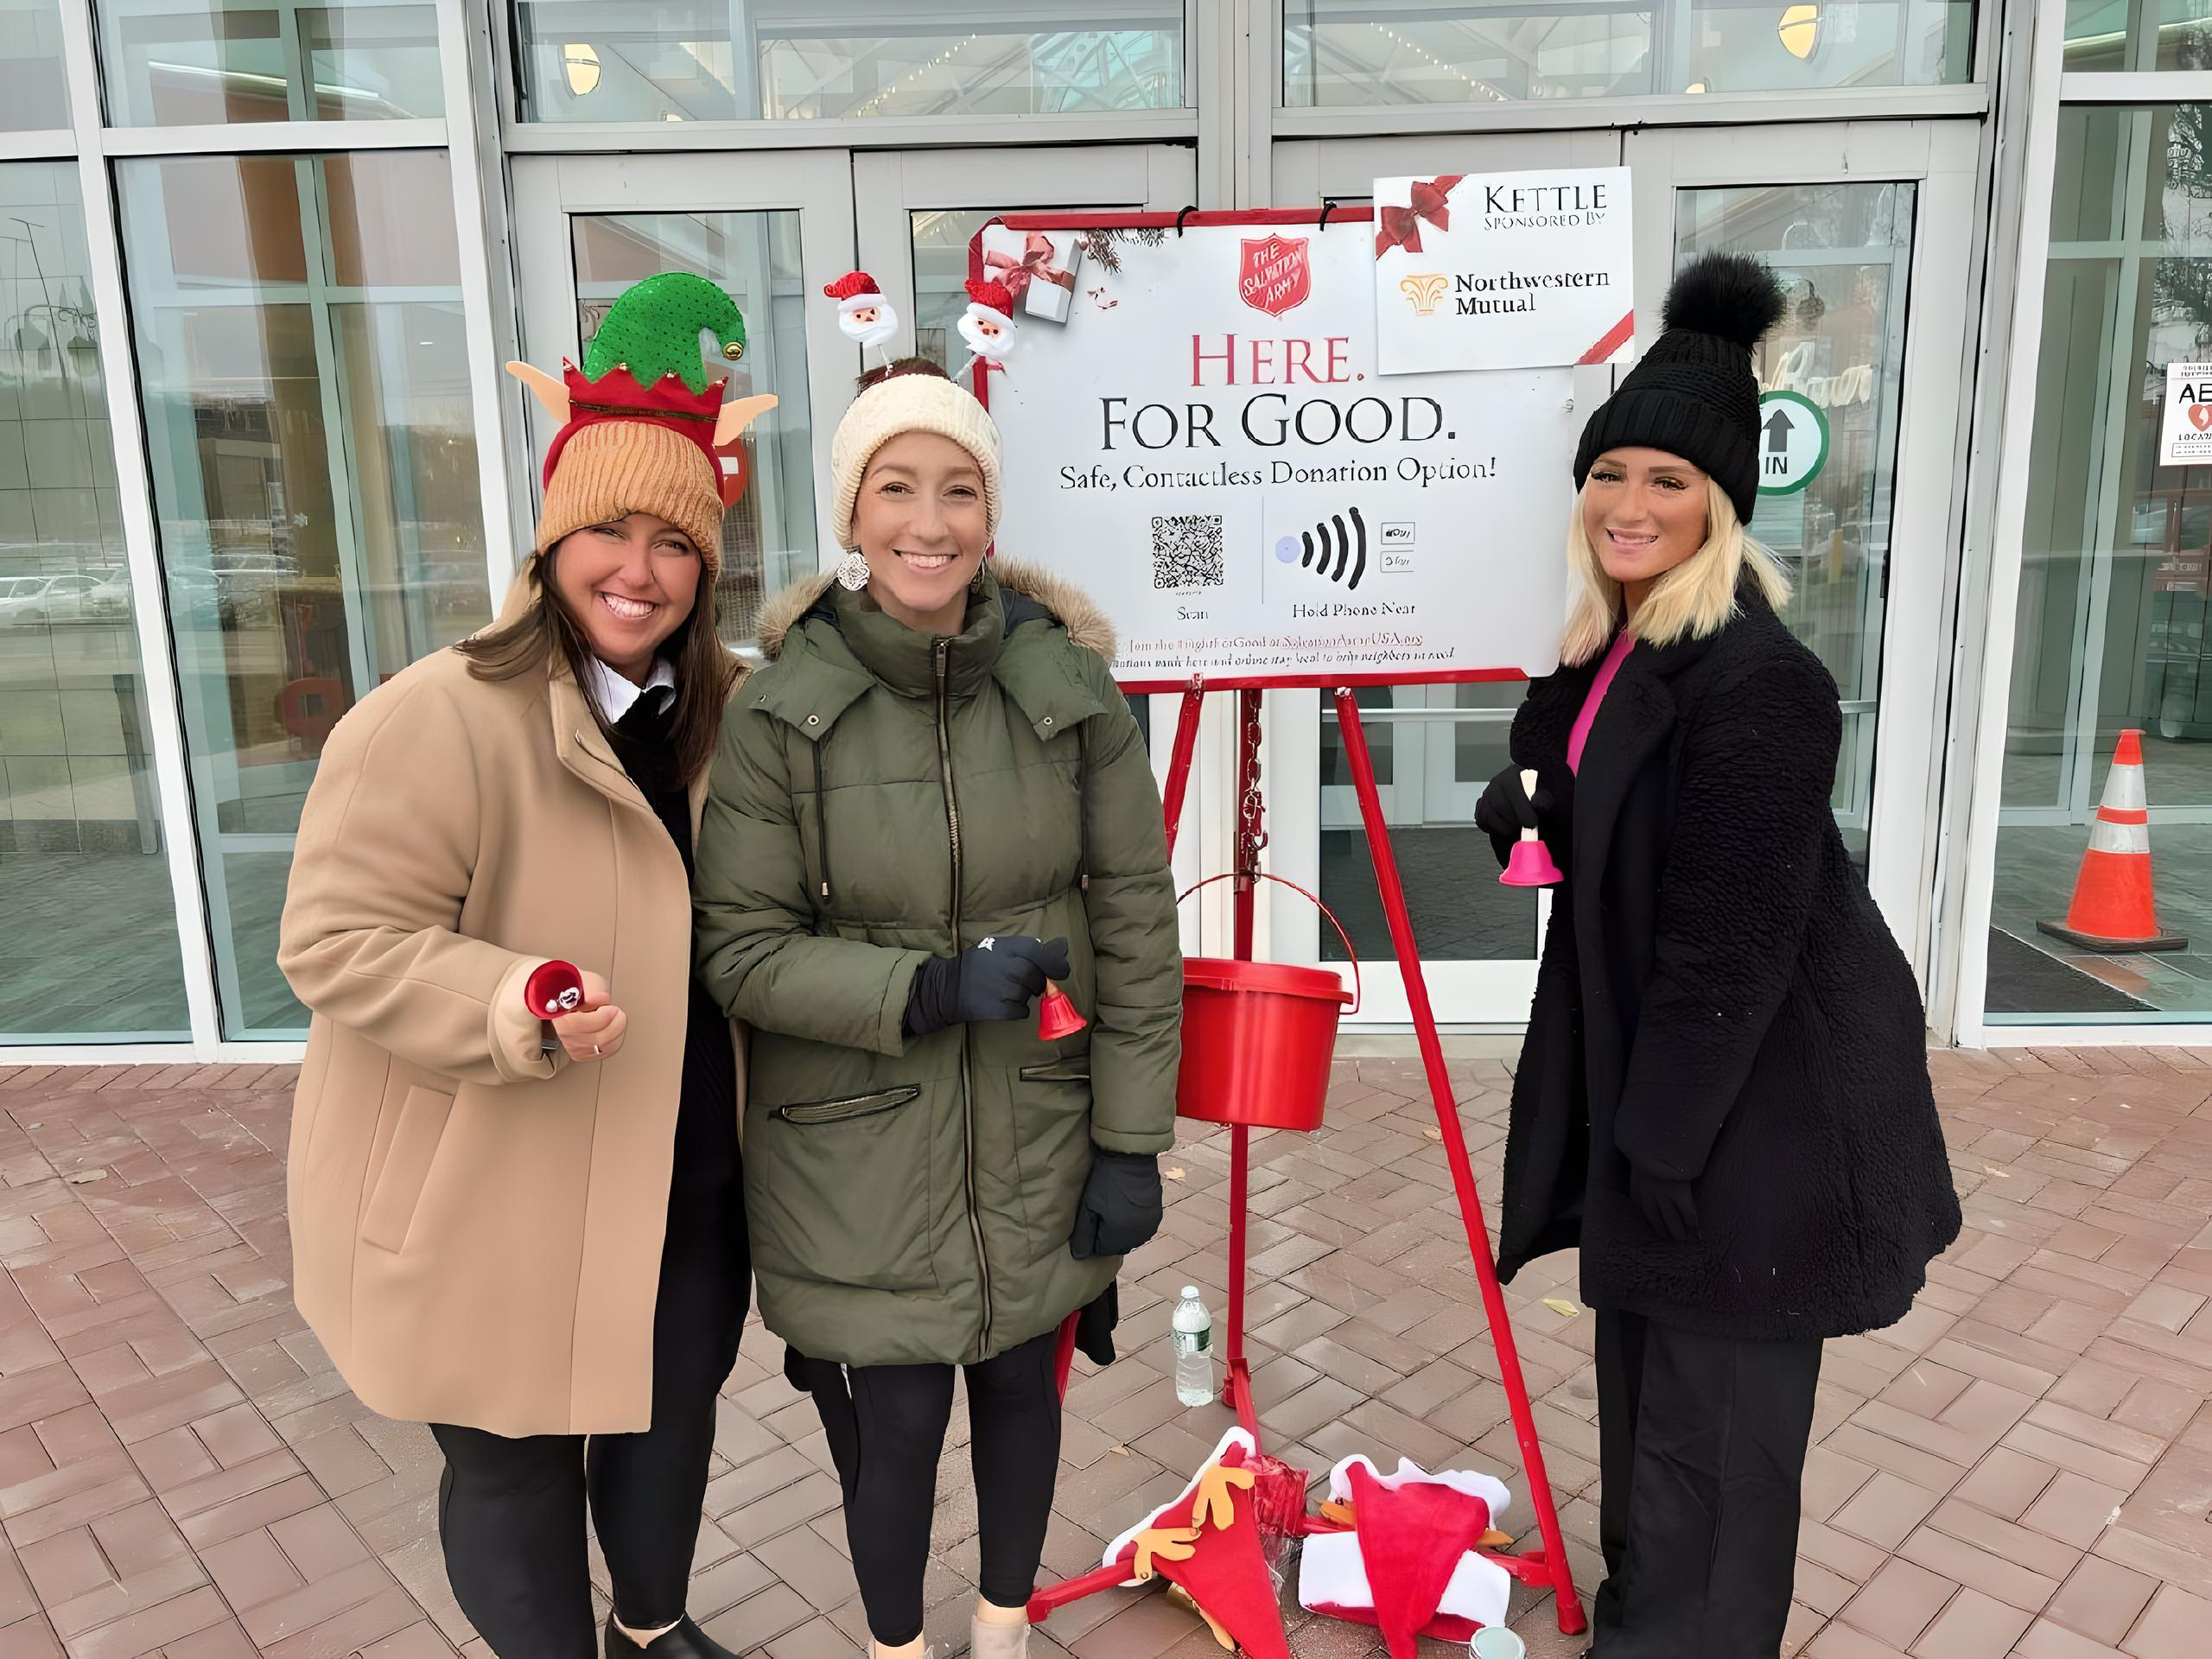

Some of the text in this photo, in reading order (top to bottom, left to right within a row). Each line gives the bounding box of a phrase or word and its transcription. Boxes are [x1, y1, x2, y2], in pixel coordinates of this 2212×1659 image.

[1484, 184, 1608, 214] KETTLE
[1484, 211, 1605, 232] SPONSORED BY
[1252, 242, 1280, 268] THE
[1264, 268, 1301, 309] ARMY
[1454, 270, 1611, 293] Northwestern
[1454, 292, 1537, 316] Mutual
[1190, 333, 1364, 387] HERE.
[1098, 392, 1457, 451] FOR GOOD.
[1059, 456, 1497, 492] Safe, Contactless Donation Option!
[1764, 456, 1789, 474] IN
[1293, 602, 1329, 619] Hold
[1332, 601, 1378, 618] Phone
